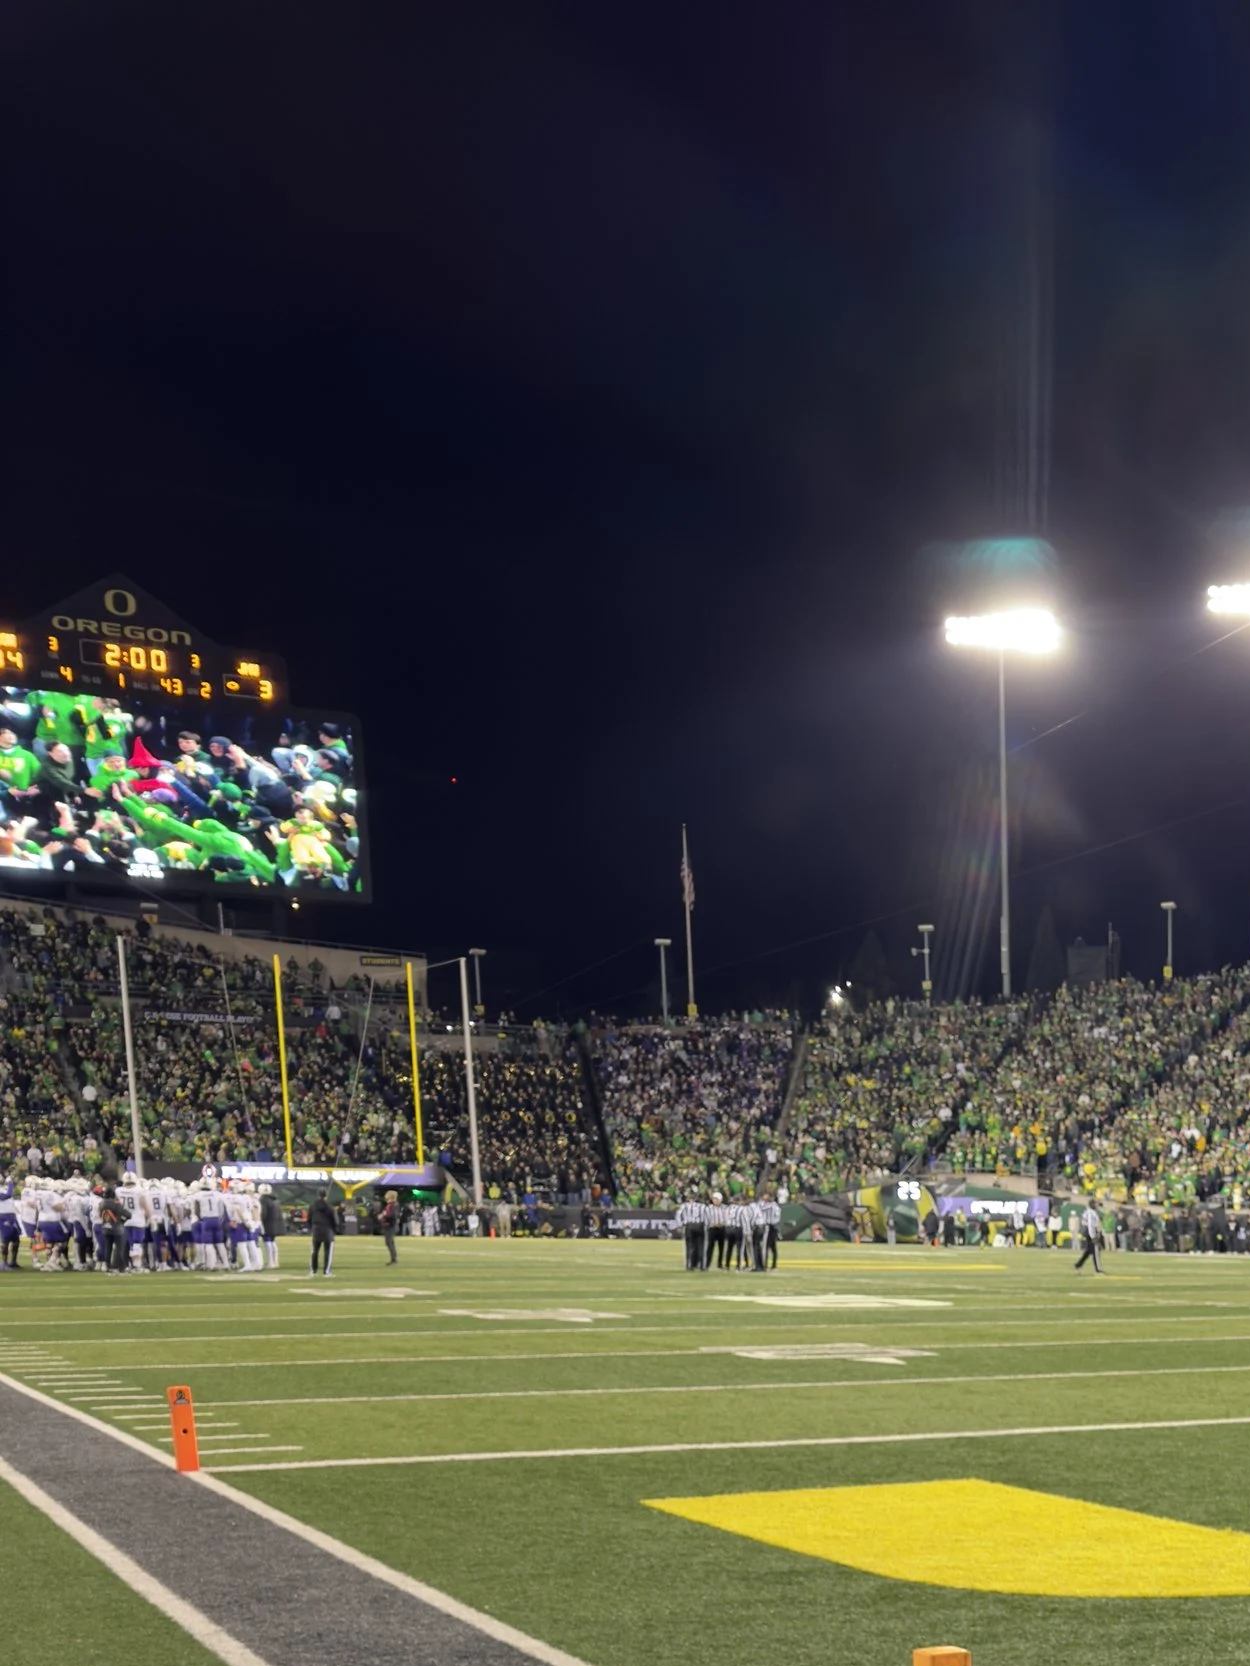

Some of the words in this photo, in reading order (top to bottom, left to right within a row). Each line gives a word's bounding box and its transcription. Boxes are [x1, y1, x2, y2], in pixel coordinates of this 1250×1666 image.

[51, 615, 192, 646] OREGON
[105, 643, 168, 673] 2:00
[60, 666, 72, 682] 4
[160, 678, 183, 696] 43
[200, 682, 211, 699] 2
[259, 680, 273, 699] 3
